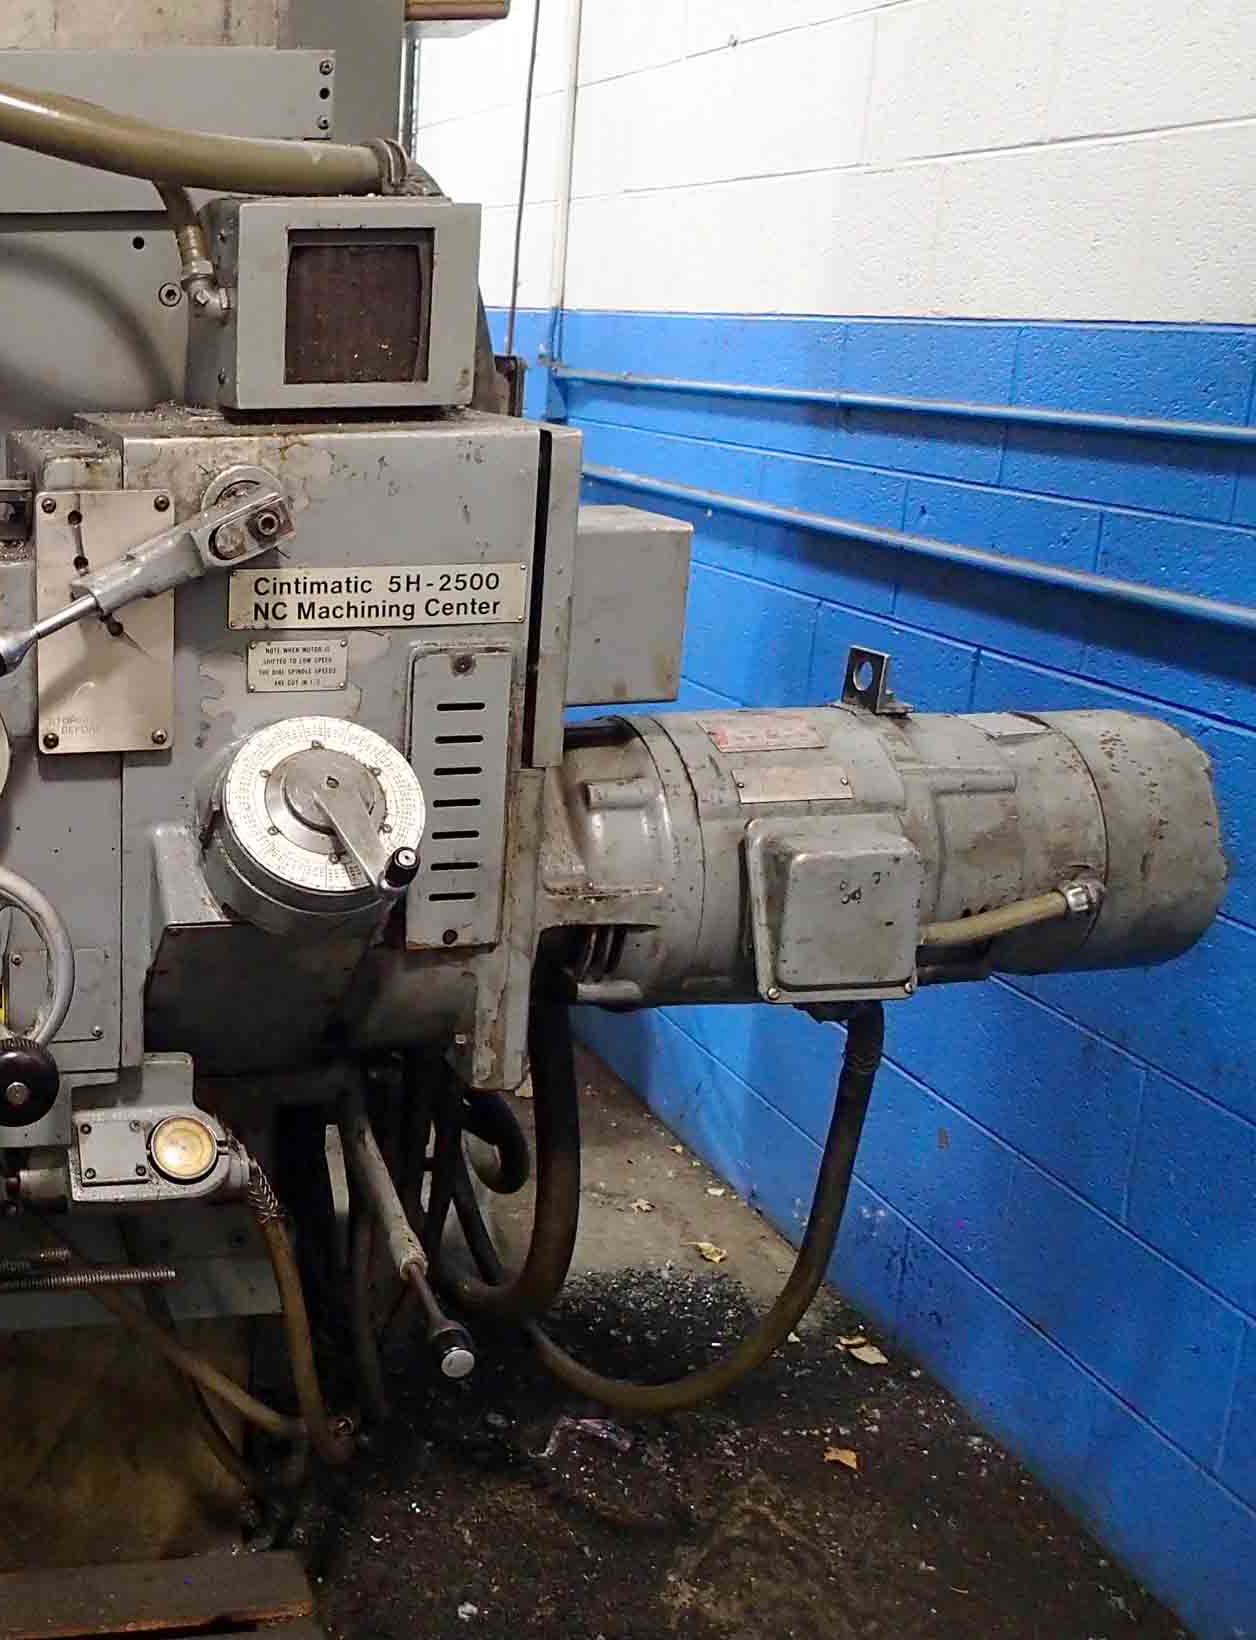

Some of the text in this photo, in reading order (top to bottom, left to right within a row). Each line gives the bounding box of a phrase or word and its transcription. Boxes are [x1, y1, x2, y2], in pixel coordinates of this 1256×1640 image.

[253, 575, 373, 596] Cintimatic
[253, 598, 501, 621] NC Machining Center
